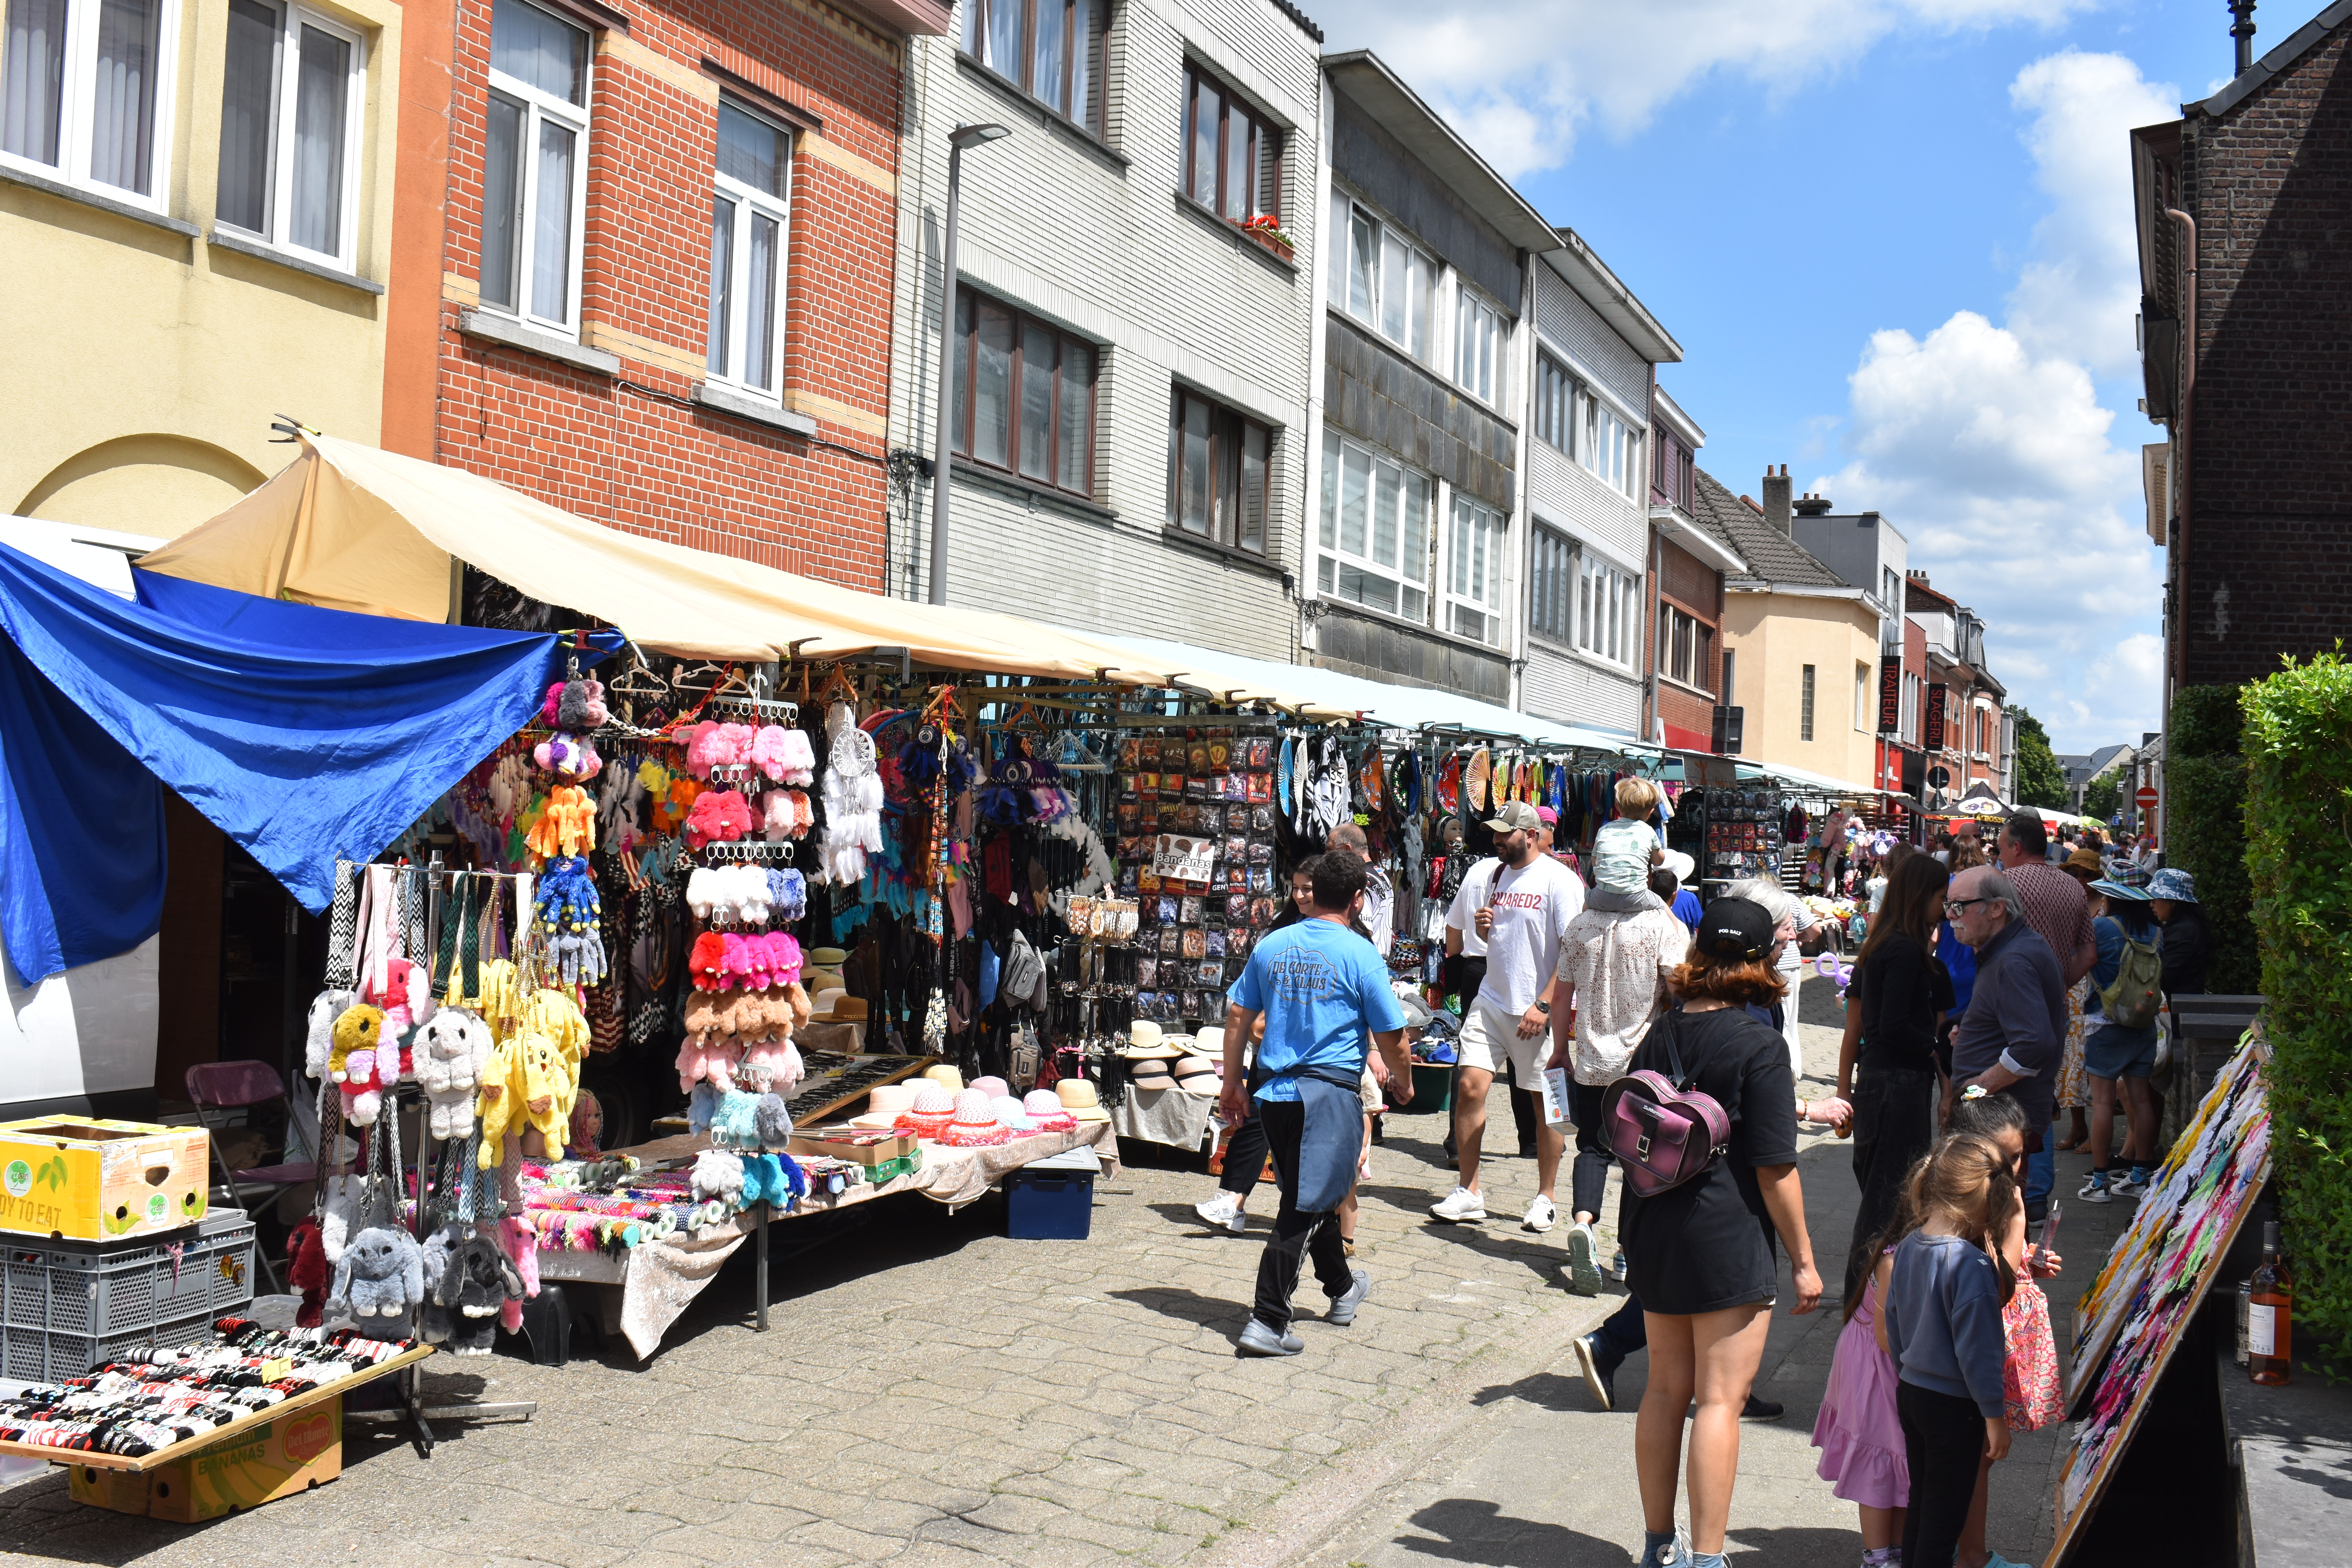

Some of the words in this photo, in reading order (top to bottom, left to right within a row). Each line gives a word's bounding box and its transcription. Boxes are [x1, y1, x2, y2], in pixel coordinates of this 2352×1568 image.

[1882, 664, 1897, 725] TRAITEUR
[1929, 690, 1943, 745] SLAGERIJ
[1159, 805, 1179, 813] NIRVANA
[1156, 851, 1211, 869] Bandanas
[1272, 961, 1287, 975] DE
[1289, 961, 1323, 976] CORTE
[1283, 975, 1291, 985] &
[1294, 975, 1326, 990] CLAUS
[19, 1198, 34, 1223] TO
[36, 1203, 62, 1229] EAT
[287, 1432, 302, 1449] Del
[303, 1425, 329, 1445] Monte
[198, 1444, 265, 1475] BANANAS
